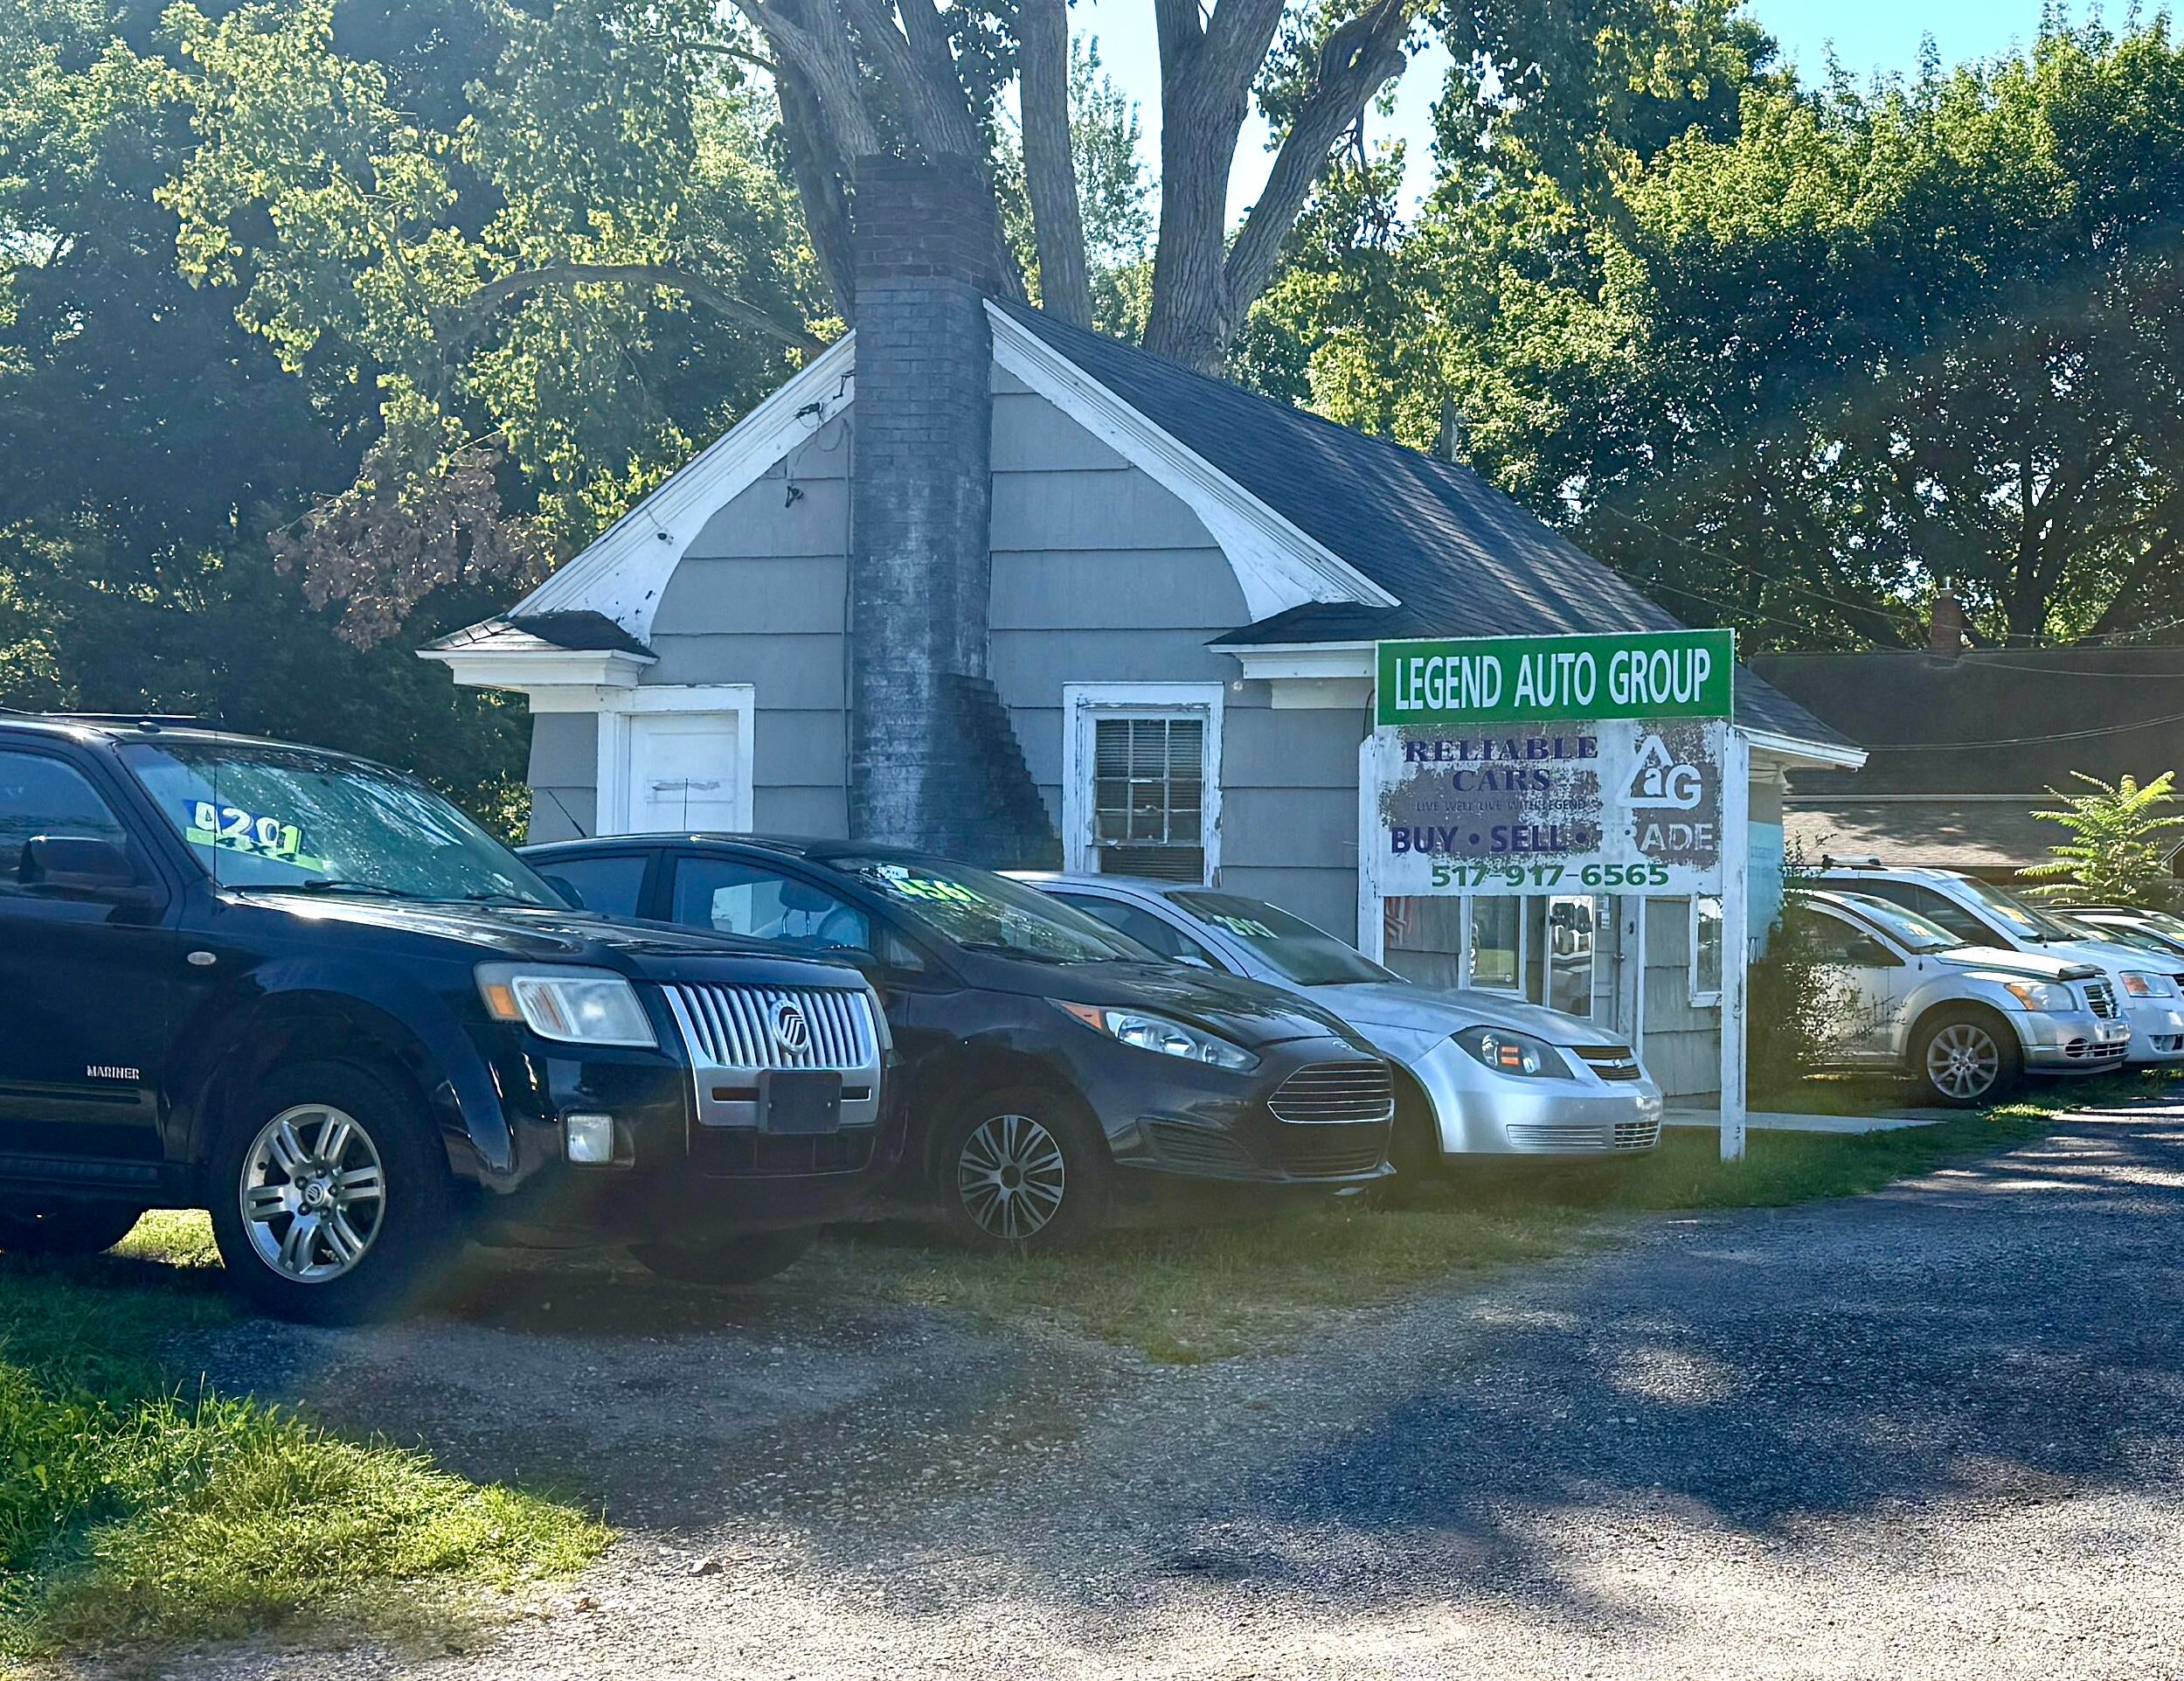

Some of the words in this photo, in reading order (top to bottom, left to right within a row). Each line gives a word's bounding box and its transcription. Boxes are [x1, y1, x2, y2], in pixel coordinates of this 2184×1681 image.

[1395, 655, 1502, 710] LEGEND
[1514, 652, 1597, 707] AUTO
[1608, 648, 1711, 705] GROUP
[1404, 736, 1598, 762] RELIABLE
[1452, 768, 1551, 791] CARS
[1391, 826, 1459, 854] BUY
[1489, 825, 1567, 853] SELL
[1431, 863, 1670, 887] 517-917-6565
[87, 1065, 140, 1080] MARINER
